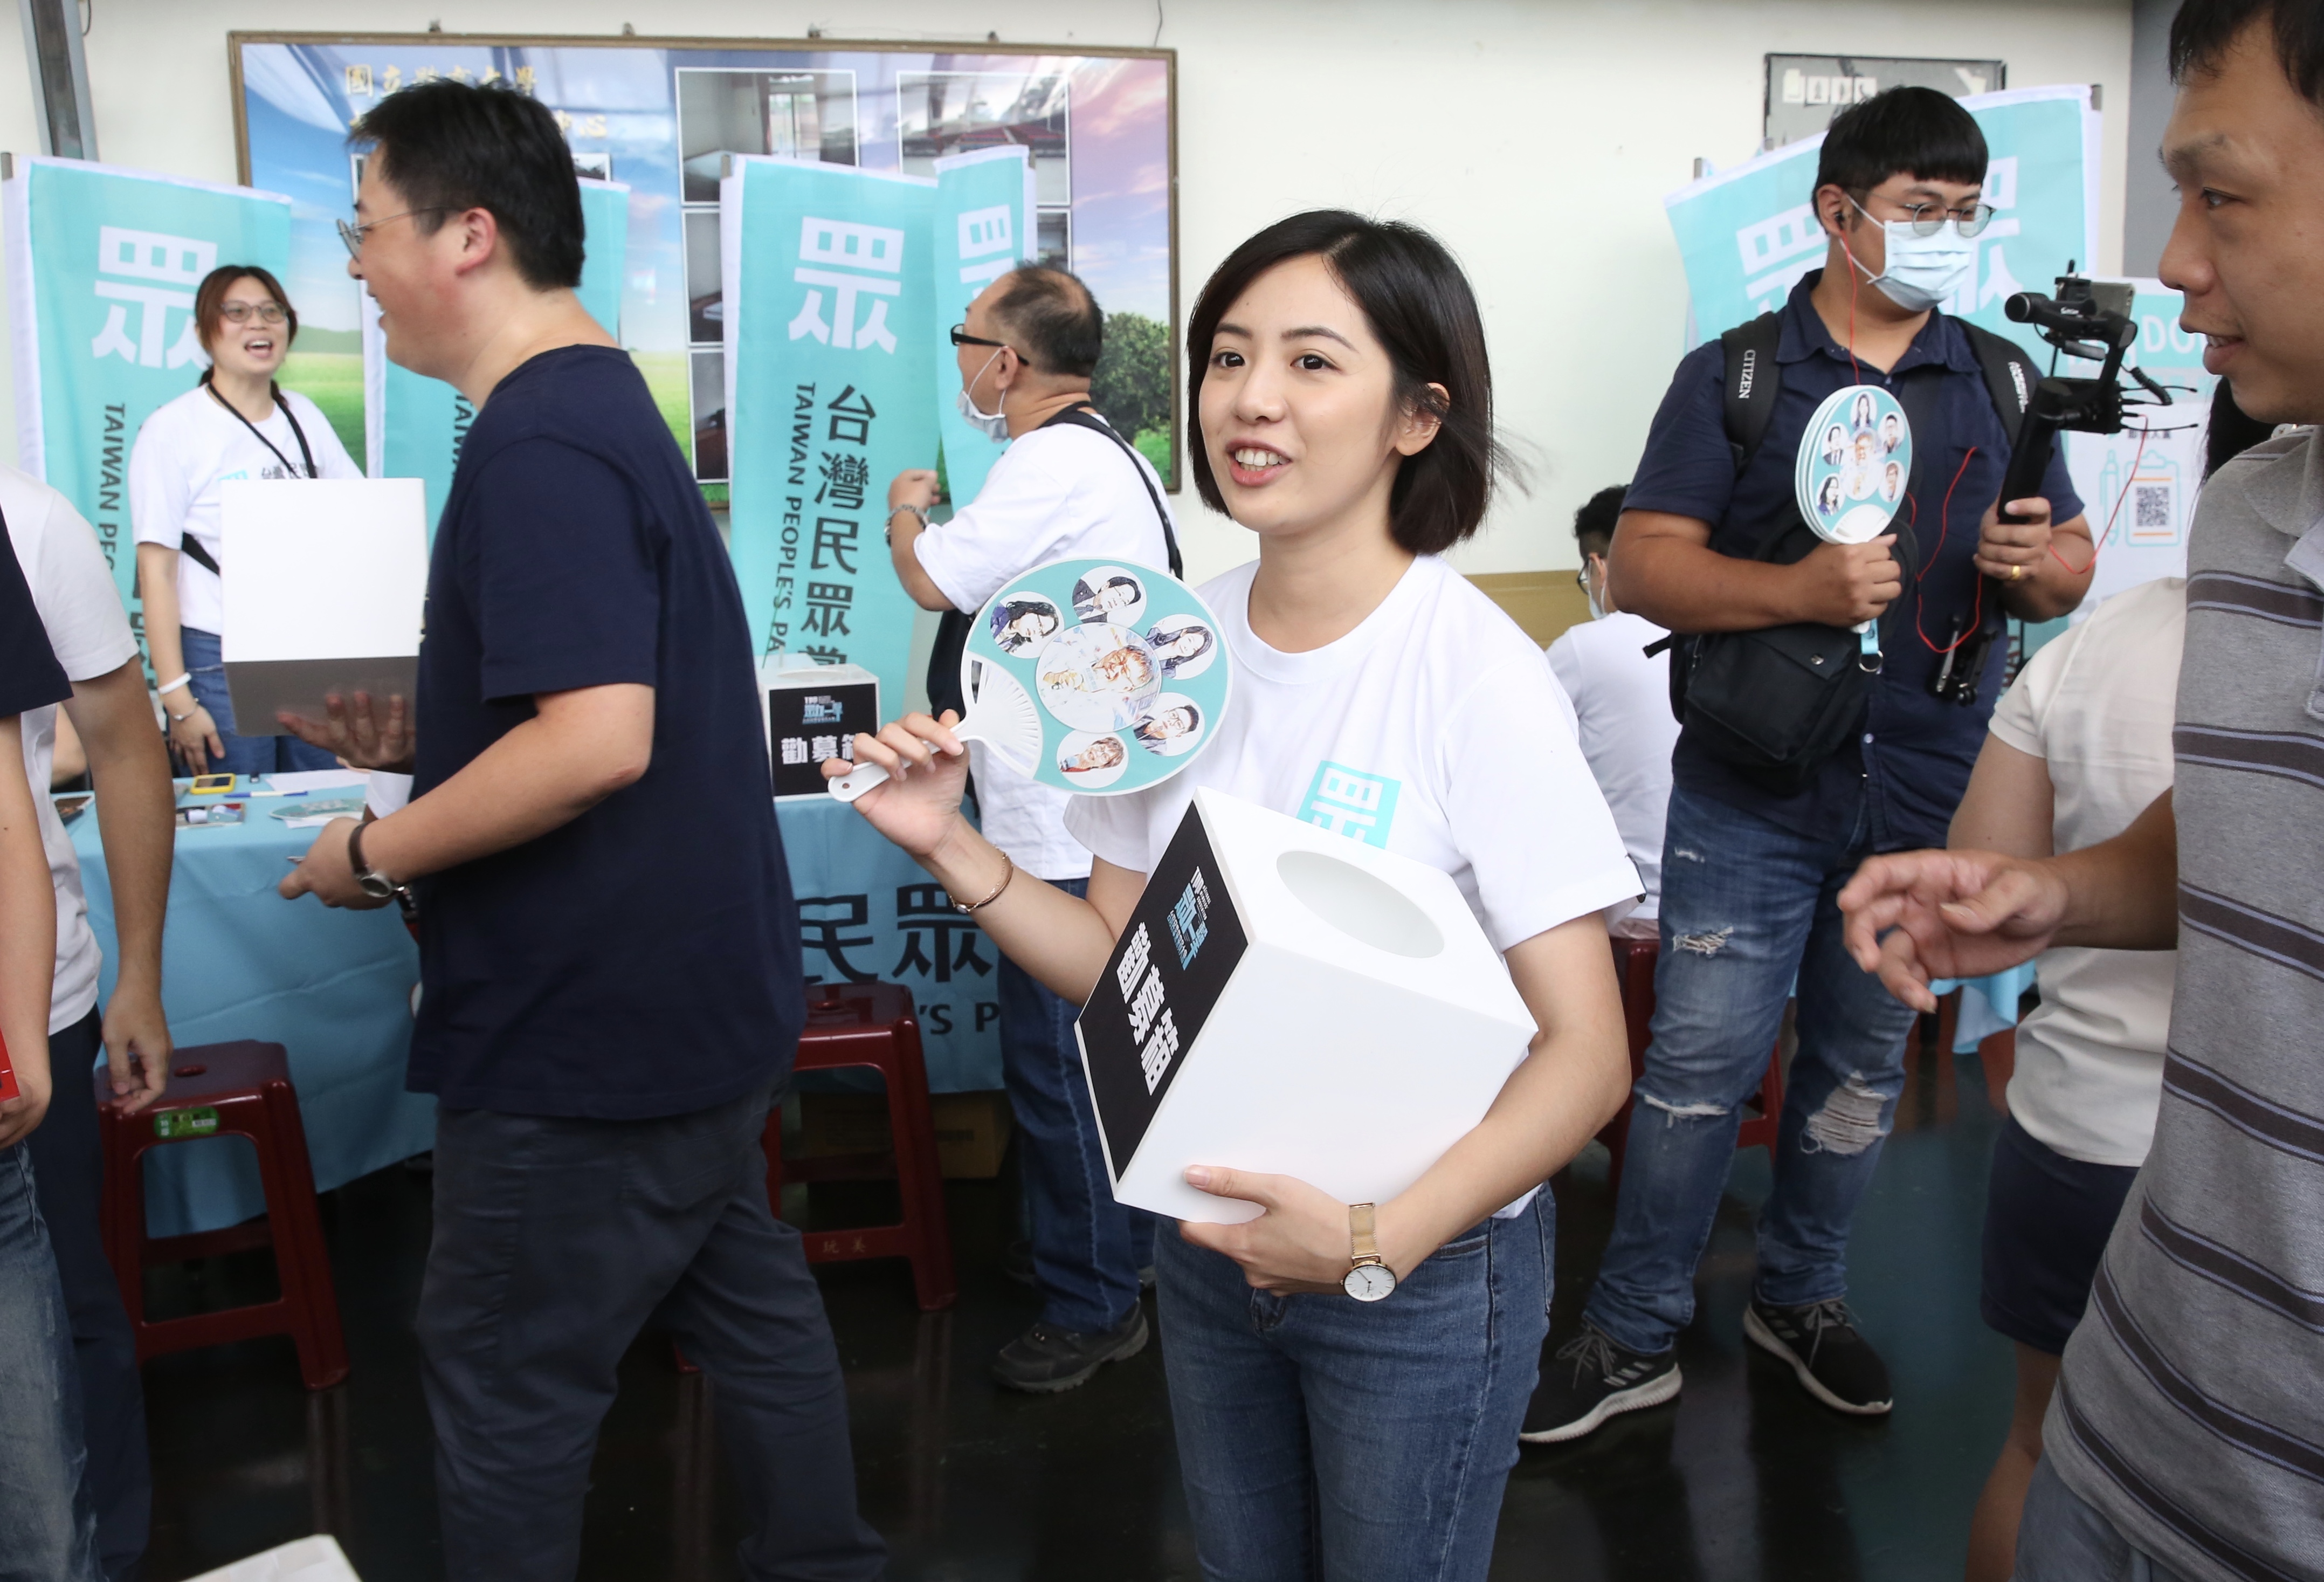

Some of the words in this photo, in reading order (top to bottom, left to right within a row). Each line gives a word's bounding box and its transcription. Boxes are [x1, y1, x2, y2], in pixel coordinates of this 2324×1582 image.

[92, 225, 218, 370] 眾
[788, 216, 905, 354] 眾
[1738, 349, 1756, 398] CITIZEN
[99, 403, 125, 511] TAIWAN
[788, 382, 816, 485] TAIWAN
[773, 496, 802, 609] PEOPLE'S
[1116, 921, 1180, 1096] 勸募箱
